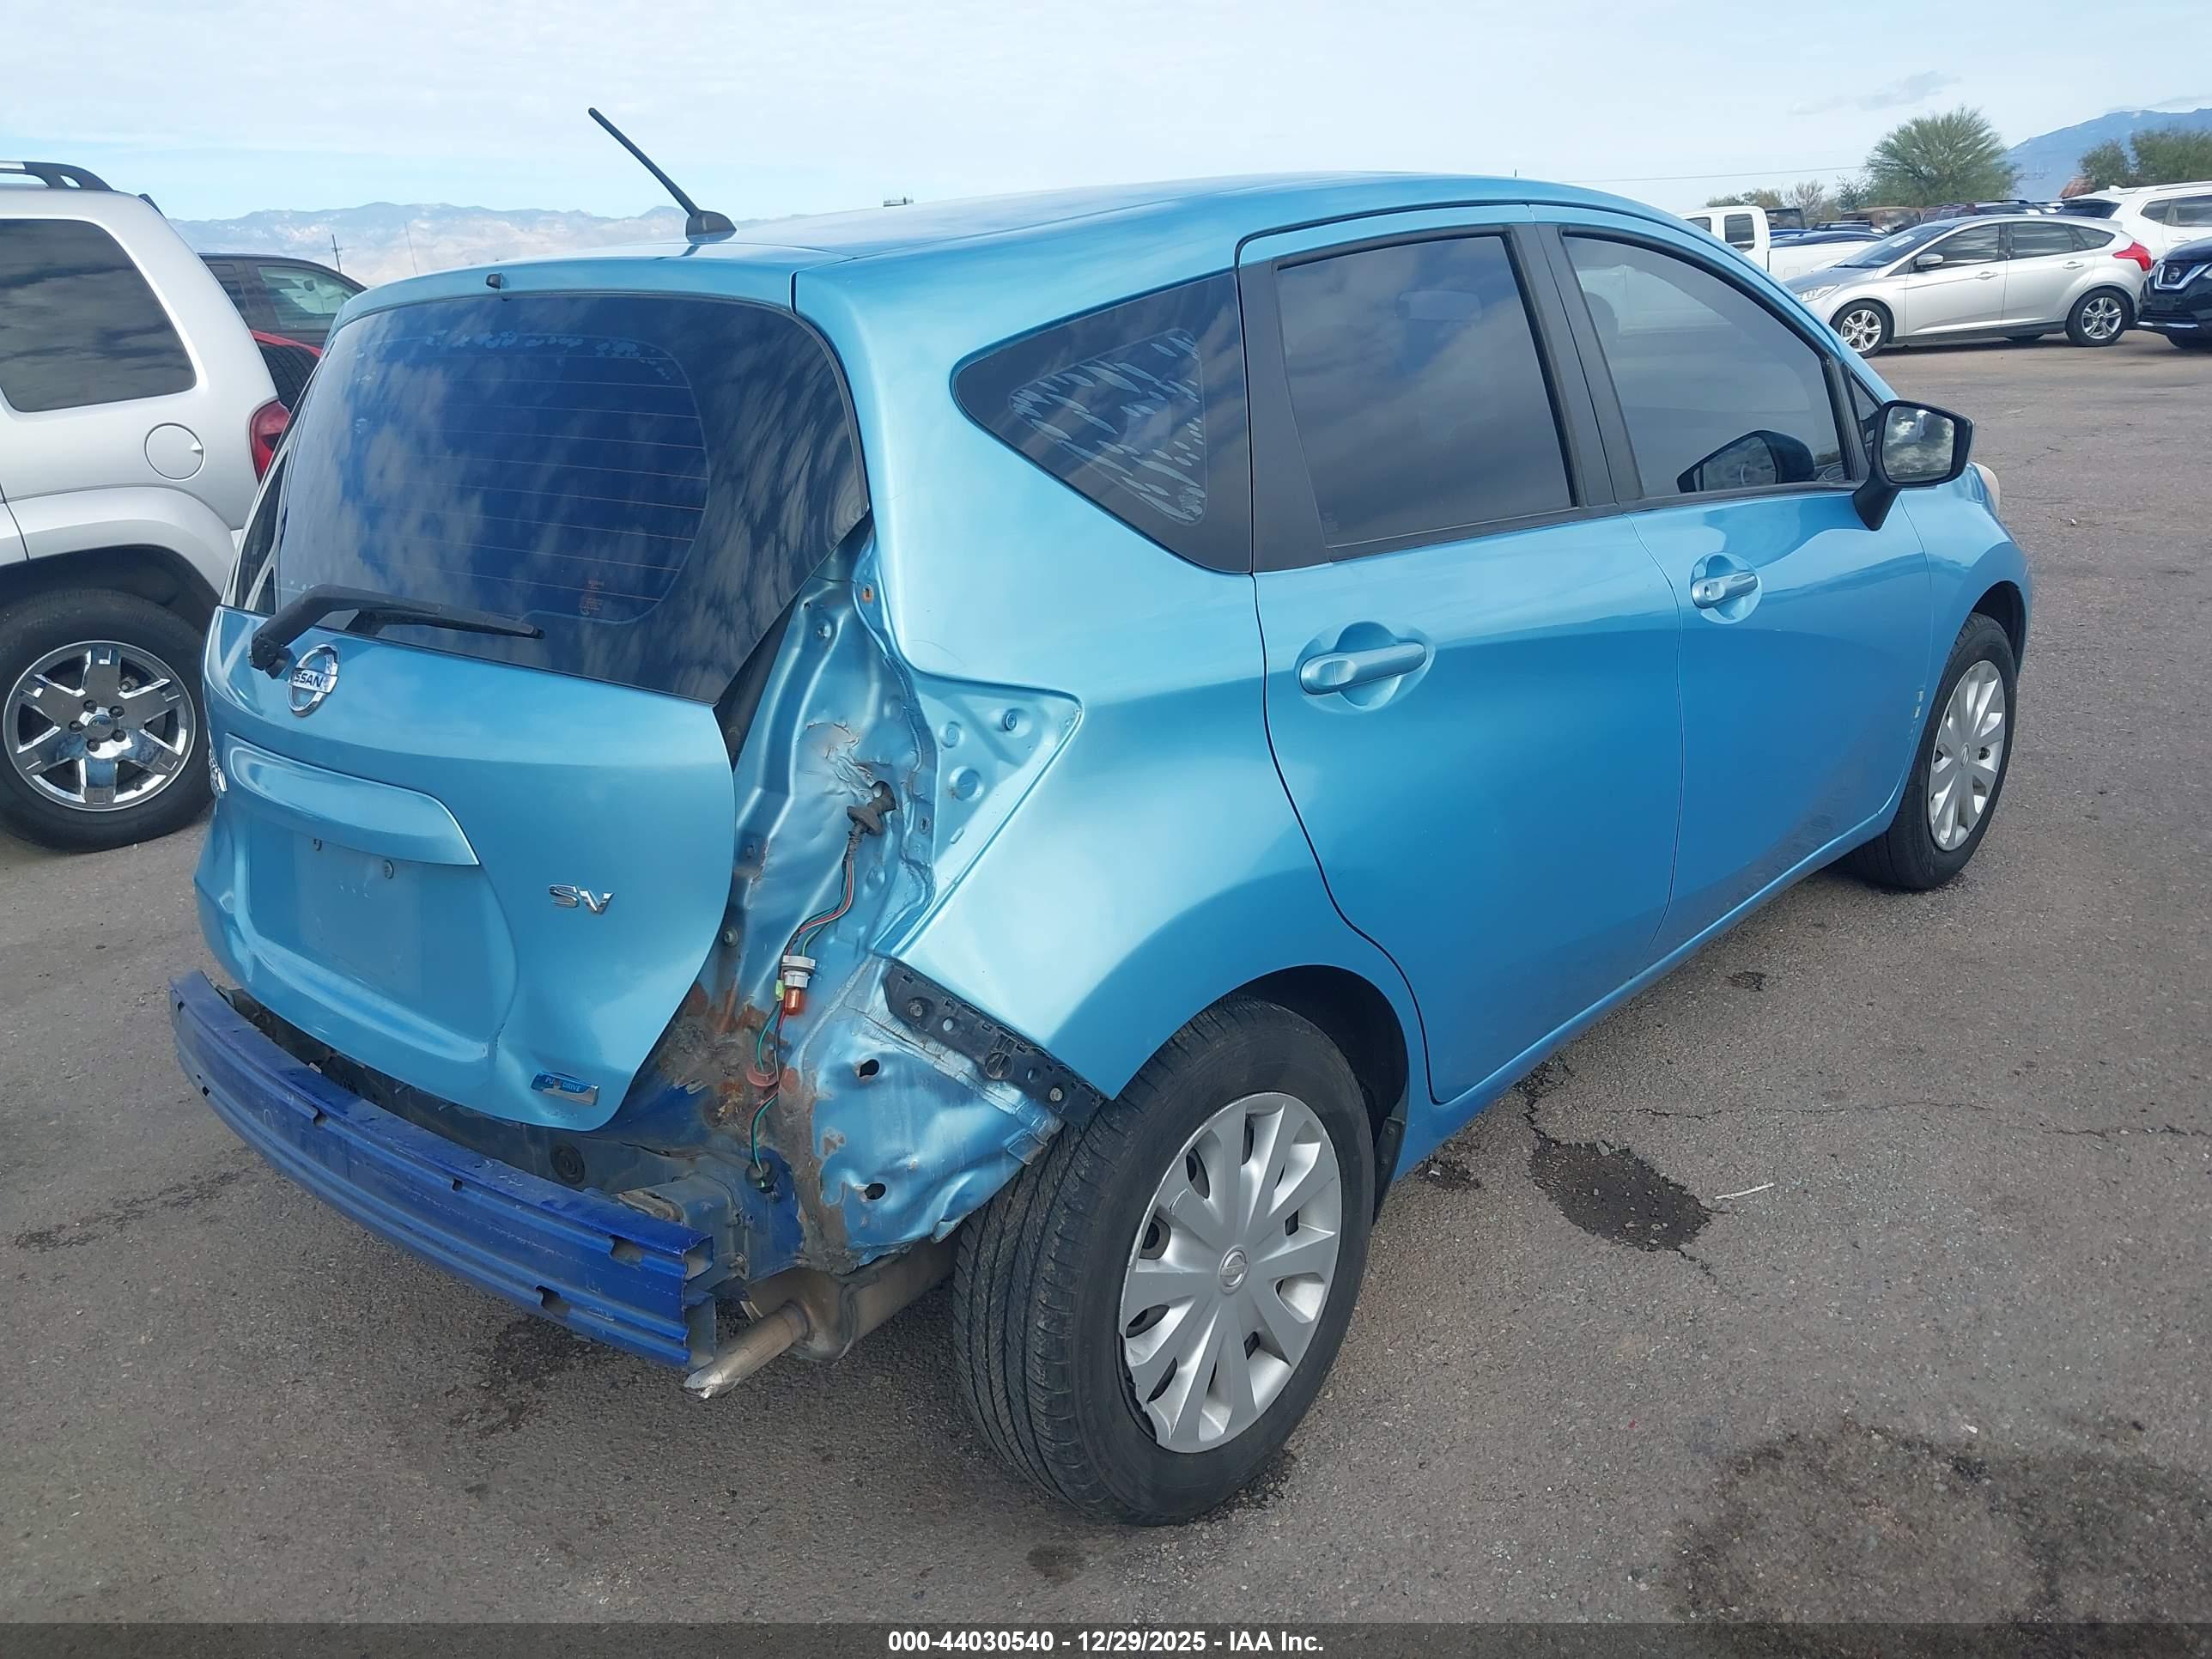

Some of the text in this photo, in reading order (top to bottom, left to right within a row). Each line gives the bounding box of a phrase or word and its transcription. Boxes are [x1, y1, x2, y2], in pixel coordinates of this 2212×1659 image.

[291, 671, 325, 688] SSAN
[549, 883, 615, 915] SV
[562, 1081, 581, 1092] DRIVE
